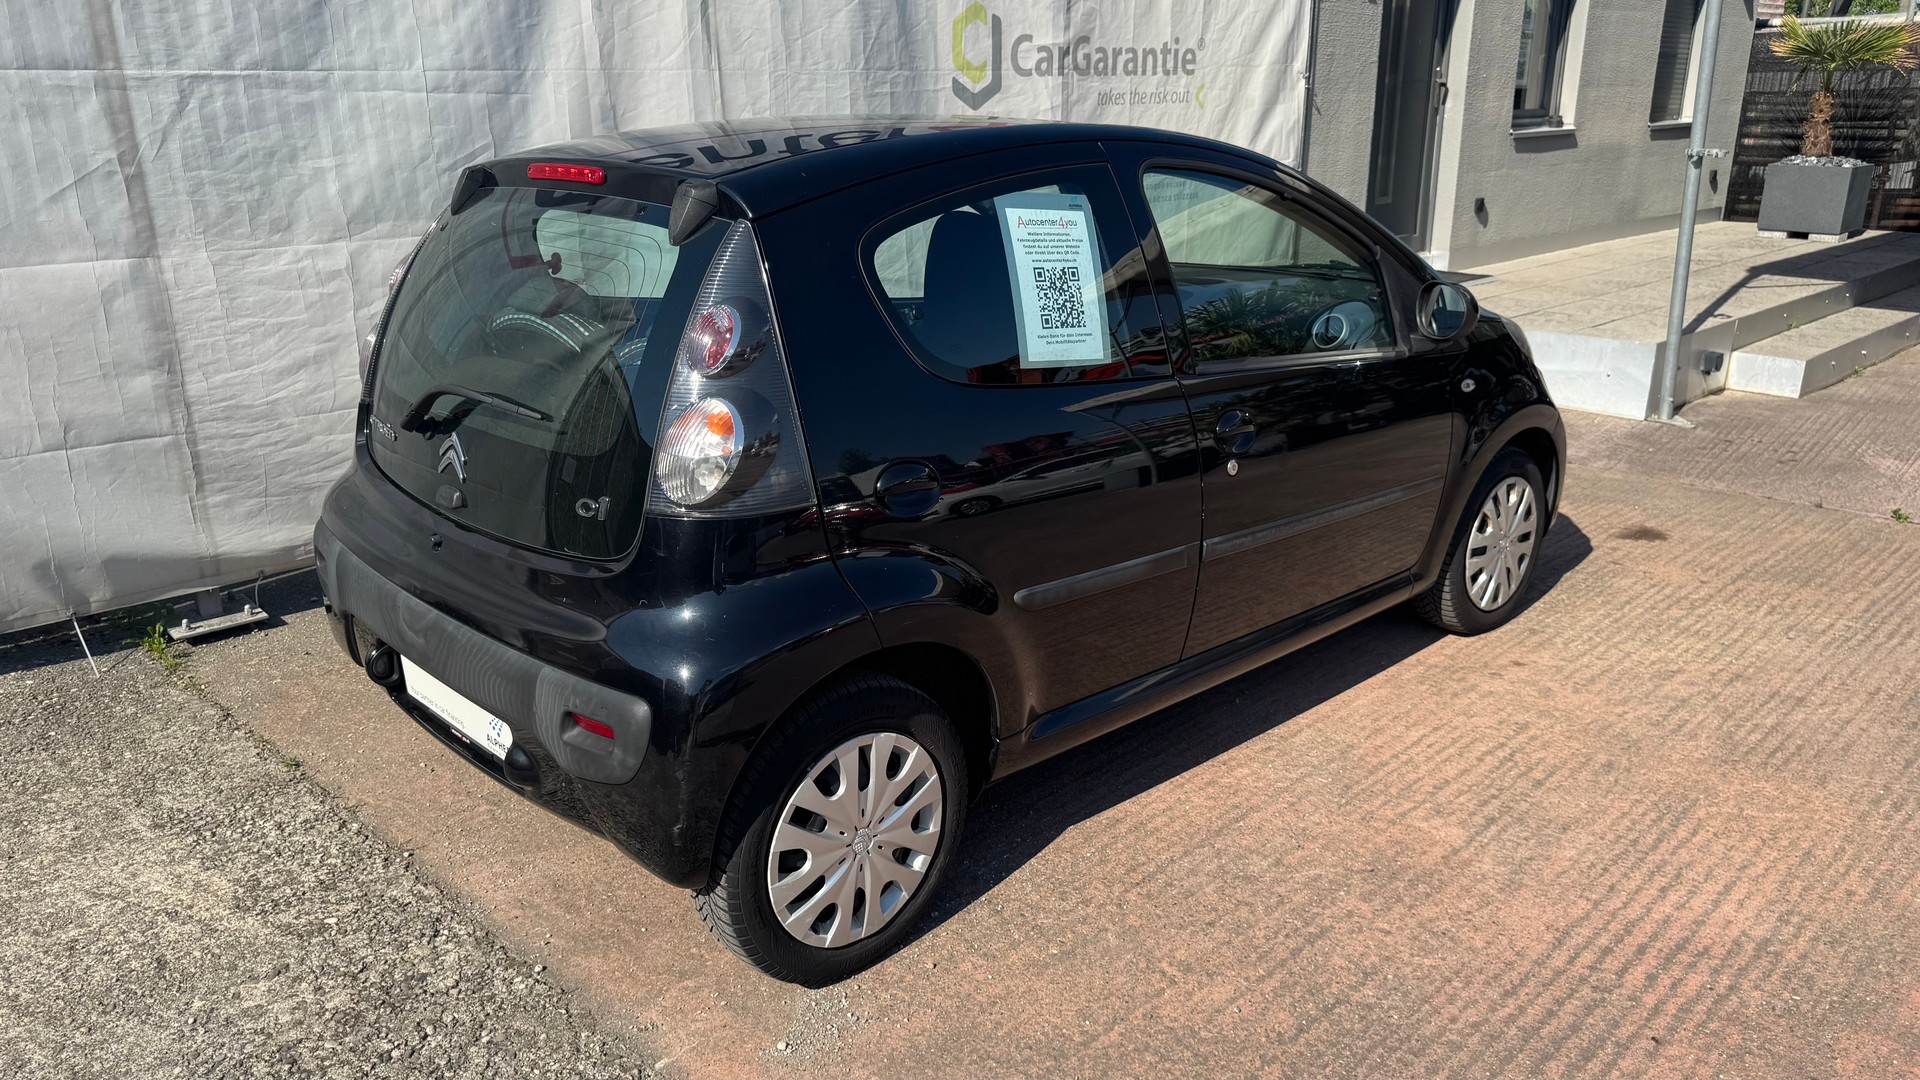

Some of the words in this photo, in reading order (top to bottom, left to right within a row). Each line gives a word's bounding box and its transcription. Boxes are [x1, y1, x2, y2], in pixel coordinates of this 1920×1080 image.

[1097, 88, 1126, 107] takes
[1129, 88, 1147, 105] the
[1149, 87, 1168, 105] risk
[1170, 88, 1190, 104] out
[1017, 215, 1077, 229] Autocenter4you
[575, 495, 611, 521] C1
